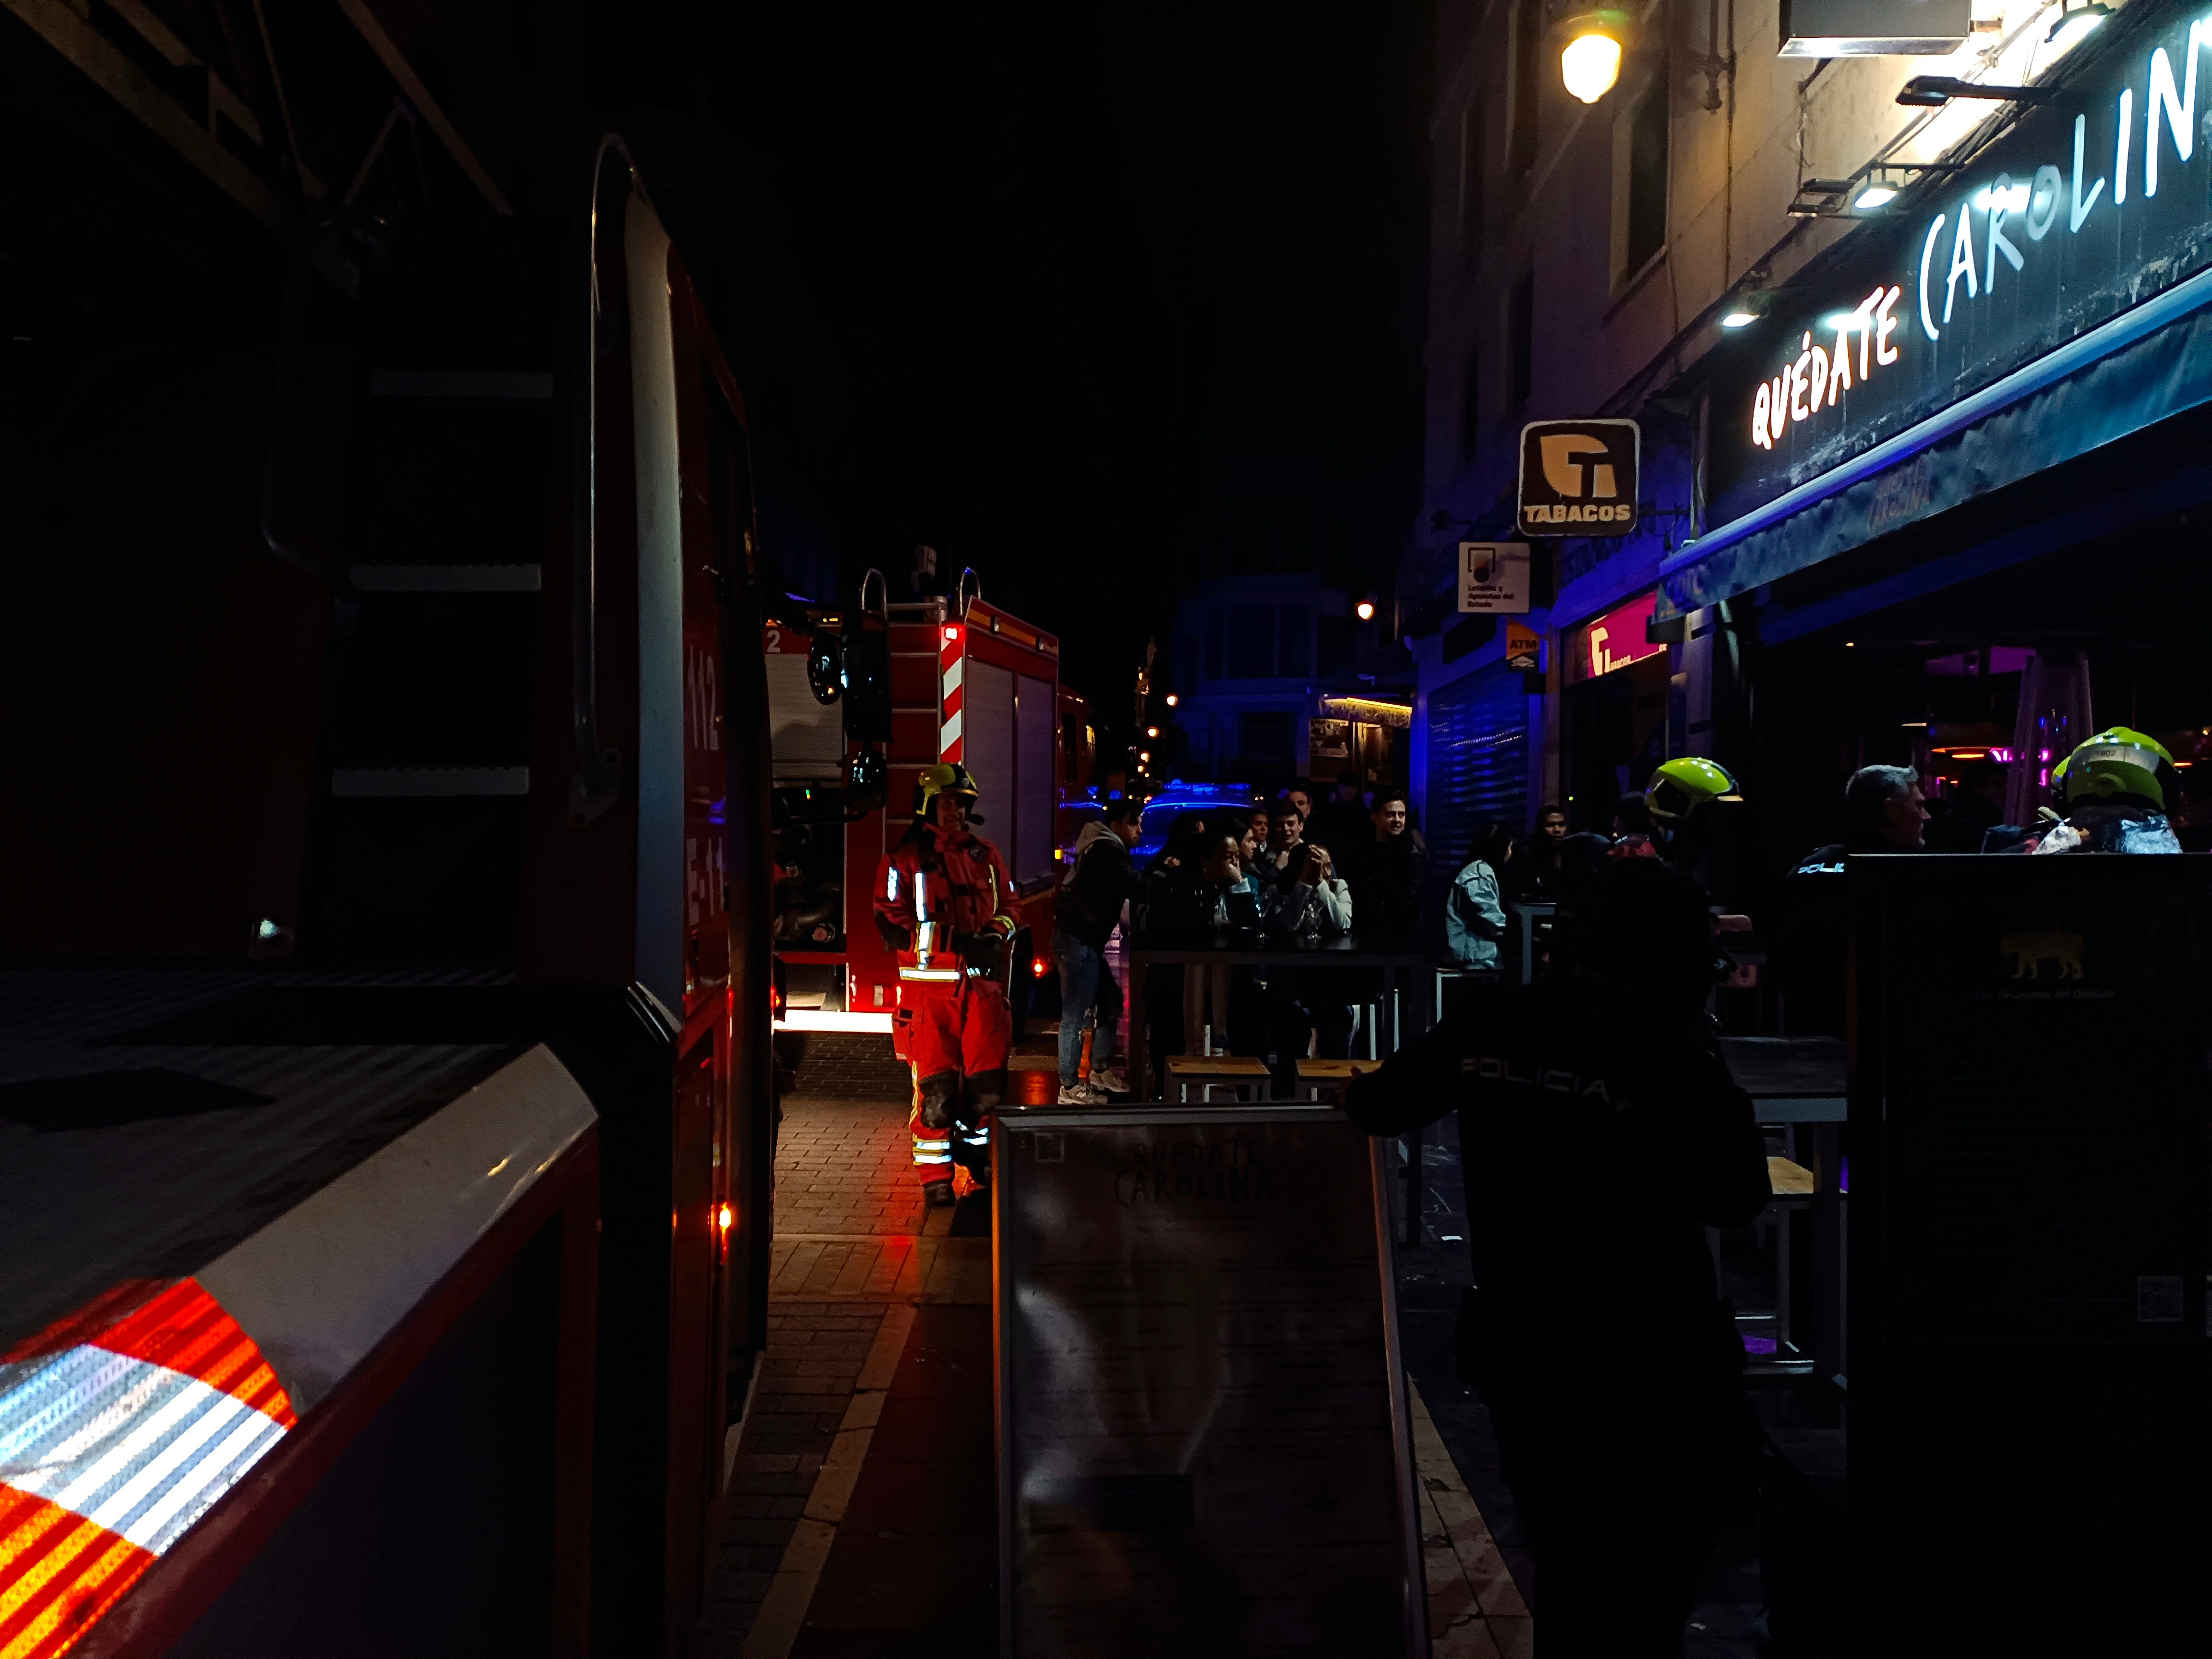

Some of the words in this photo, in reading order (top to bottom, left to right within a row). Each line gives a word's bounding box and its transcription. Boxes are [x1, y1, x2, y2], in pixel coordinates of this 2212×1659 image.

[1752, 285, 1901, 450] QUÉDATE
[1523, 504, 1631, 523] TABACOS
[1509, 639, 1537, 649] ATM
[686, 642, 719, 752] 112
[1114, 1166, 1275, 1207] CAROLINA
